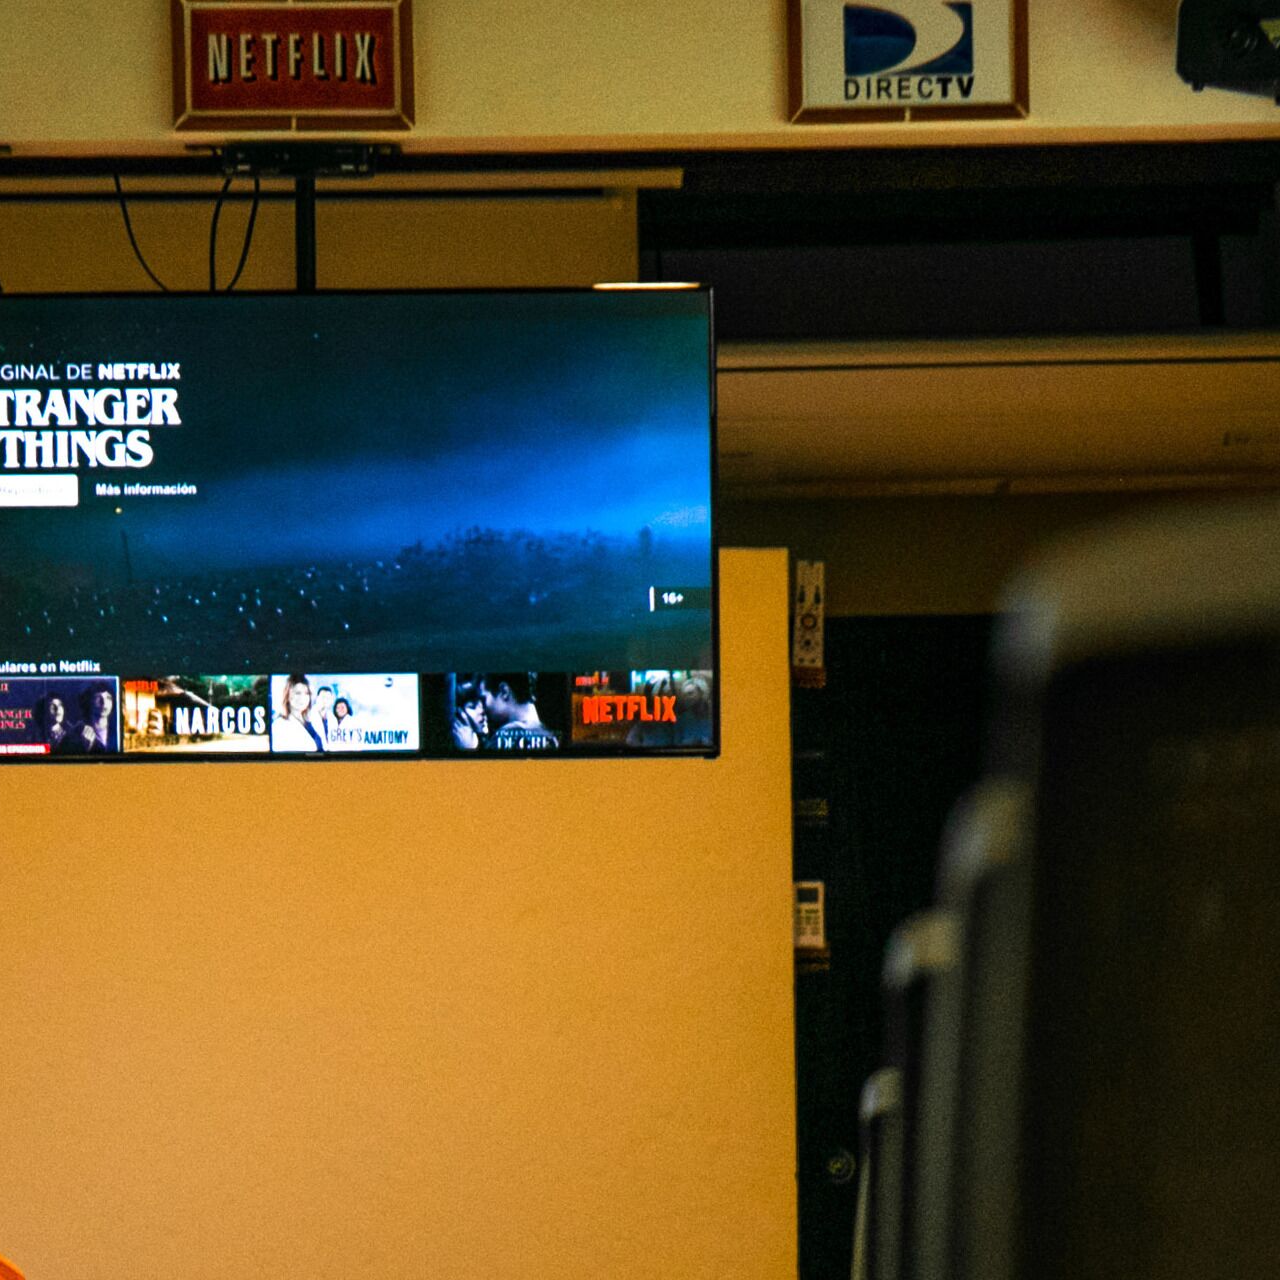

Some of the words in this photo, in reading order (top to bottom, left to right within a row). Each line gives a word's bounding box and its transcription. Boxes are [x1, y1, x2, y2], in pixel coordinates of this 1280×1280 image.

[208, 31, 377, 86] NETFLIX
[844, 76, 975, 100] DIRECTV
[67, 364, 93, 380] DE
[98, 362, 181, 380] NETFLIX
[95, 483, 121, 496] Más
[124, 483, 197, 495] información
[39, 662, 56, 673] en
[59, 660, 101, 673] Netflix
[175, 705, 266, 735] NARCOS
[582, 696, 677, 723] NETFLIX
[330, 729, 362, 743] GREY'S
[363, 730, 409, 745] ANATOMY
